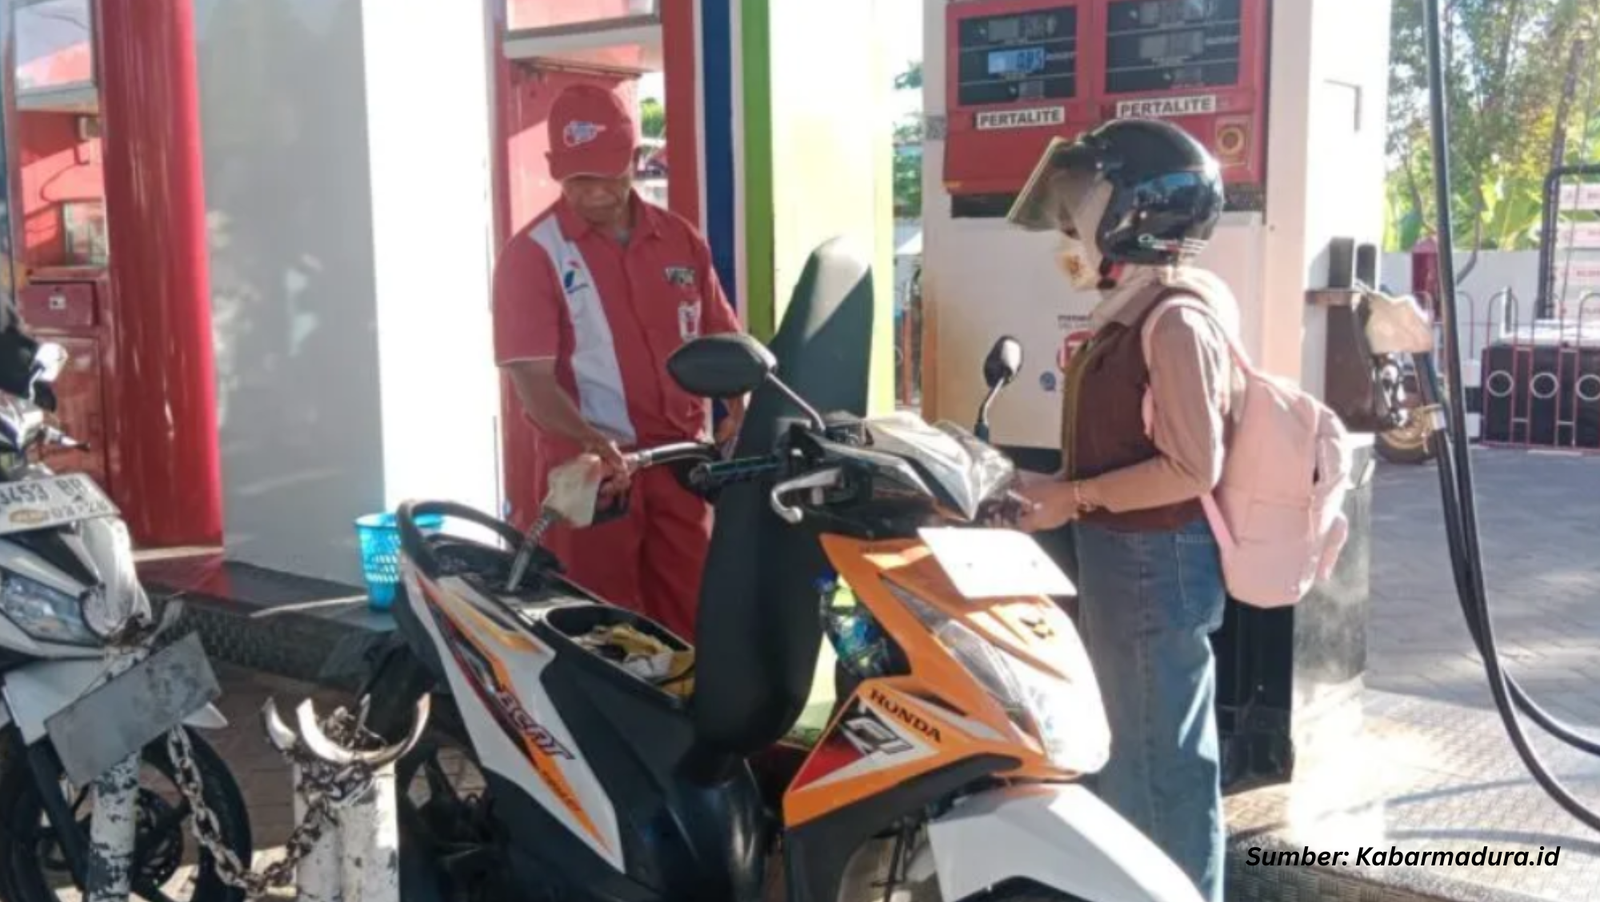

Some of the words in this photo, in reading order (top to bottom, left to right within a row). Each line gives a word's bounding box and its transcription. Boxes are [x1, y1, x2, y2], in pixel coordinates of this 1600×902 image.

[979, 109, 1061, 127] PERTALITE
[1119, 97, 1212, 118] PERTALITE
[870, 688, 942, 744] HONDA
